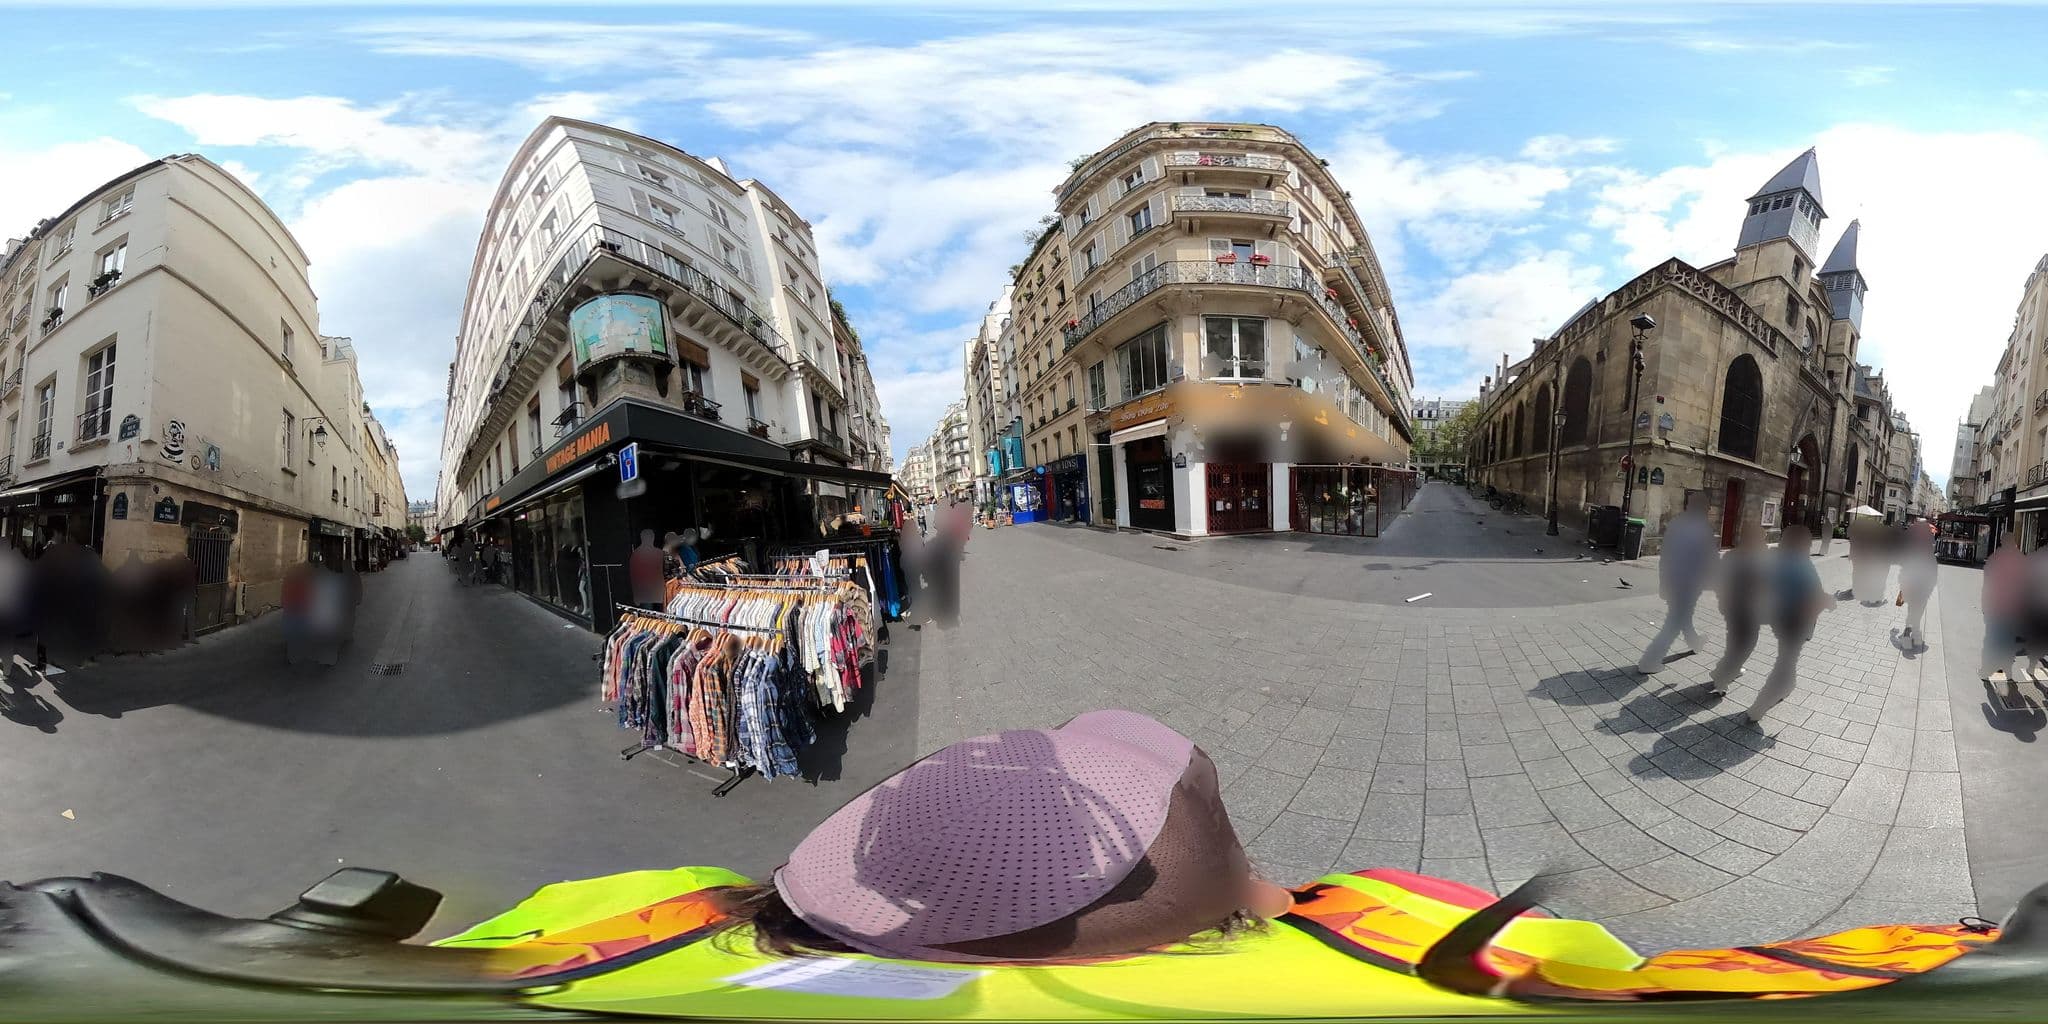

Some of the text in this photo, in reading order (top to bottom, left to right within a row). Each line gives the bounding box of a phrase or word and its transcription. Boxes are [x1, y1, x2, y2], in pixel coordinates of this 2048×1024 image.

[546, 422, 611, 474] VINTAGE MANIA
[55, 493, 74, 504] PARIS
